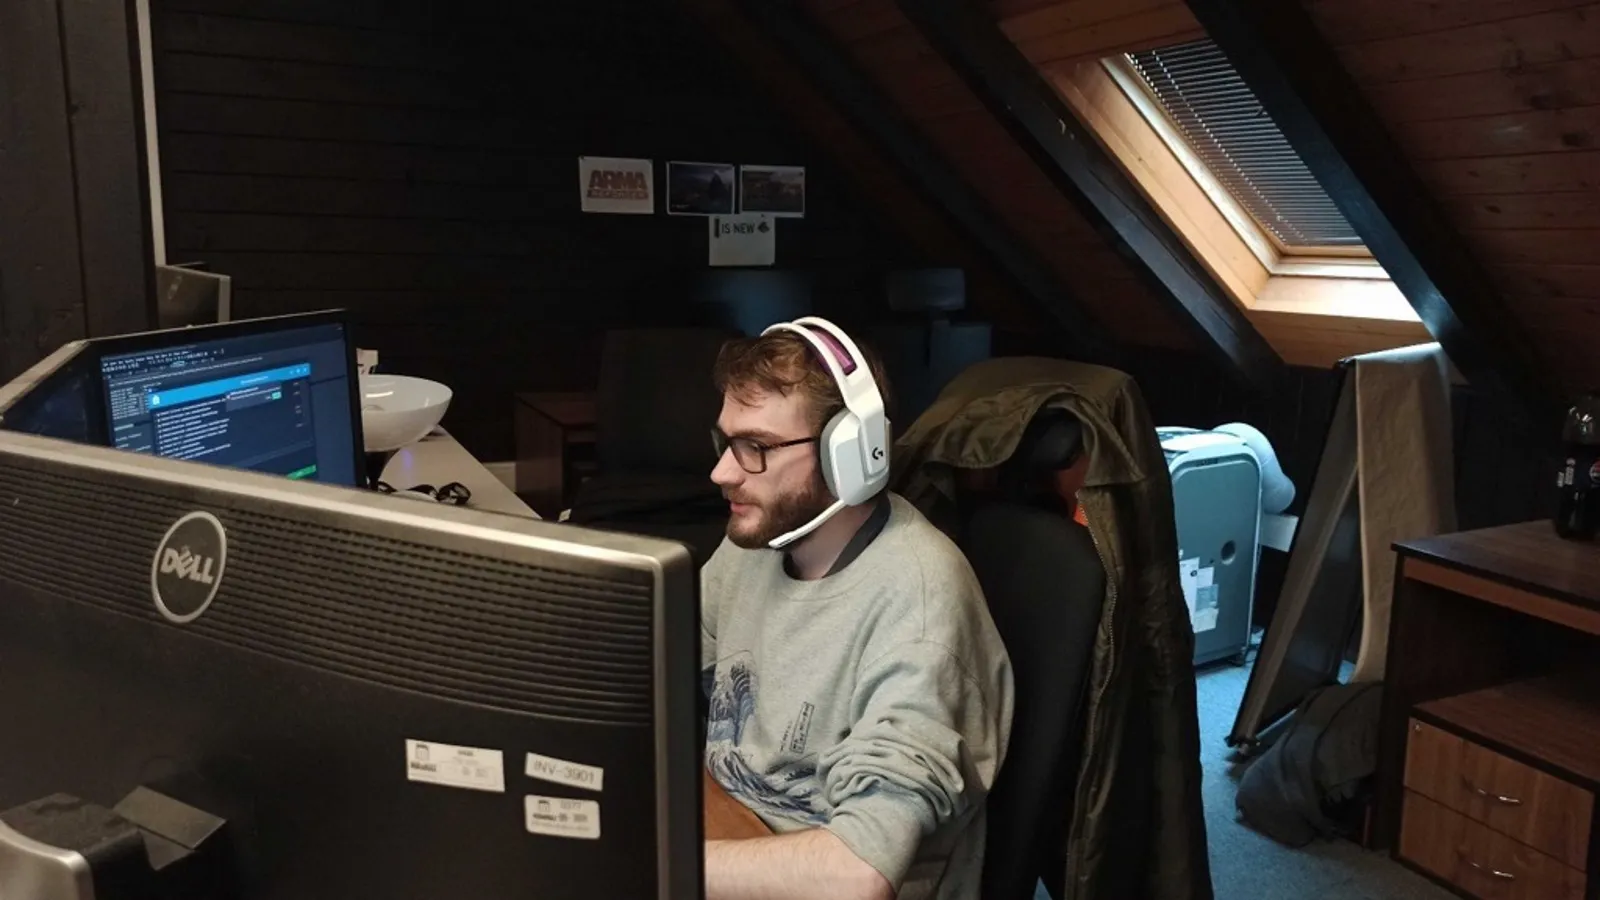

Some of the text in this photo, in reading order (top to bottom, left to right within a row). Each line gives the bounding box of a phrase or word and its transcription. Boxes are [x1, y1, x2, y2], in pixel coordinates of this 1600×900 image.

[588, 169, 648, 190] ARMA
[721, 222, 755, 234] IS NEW
[160, 546, 214, 585] DELL
[533, 759, 595, 785] INV-3901
